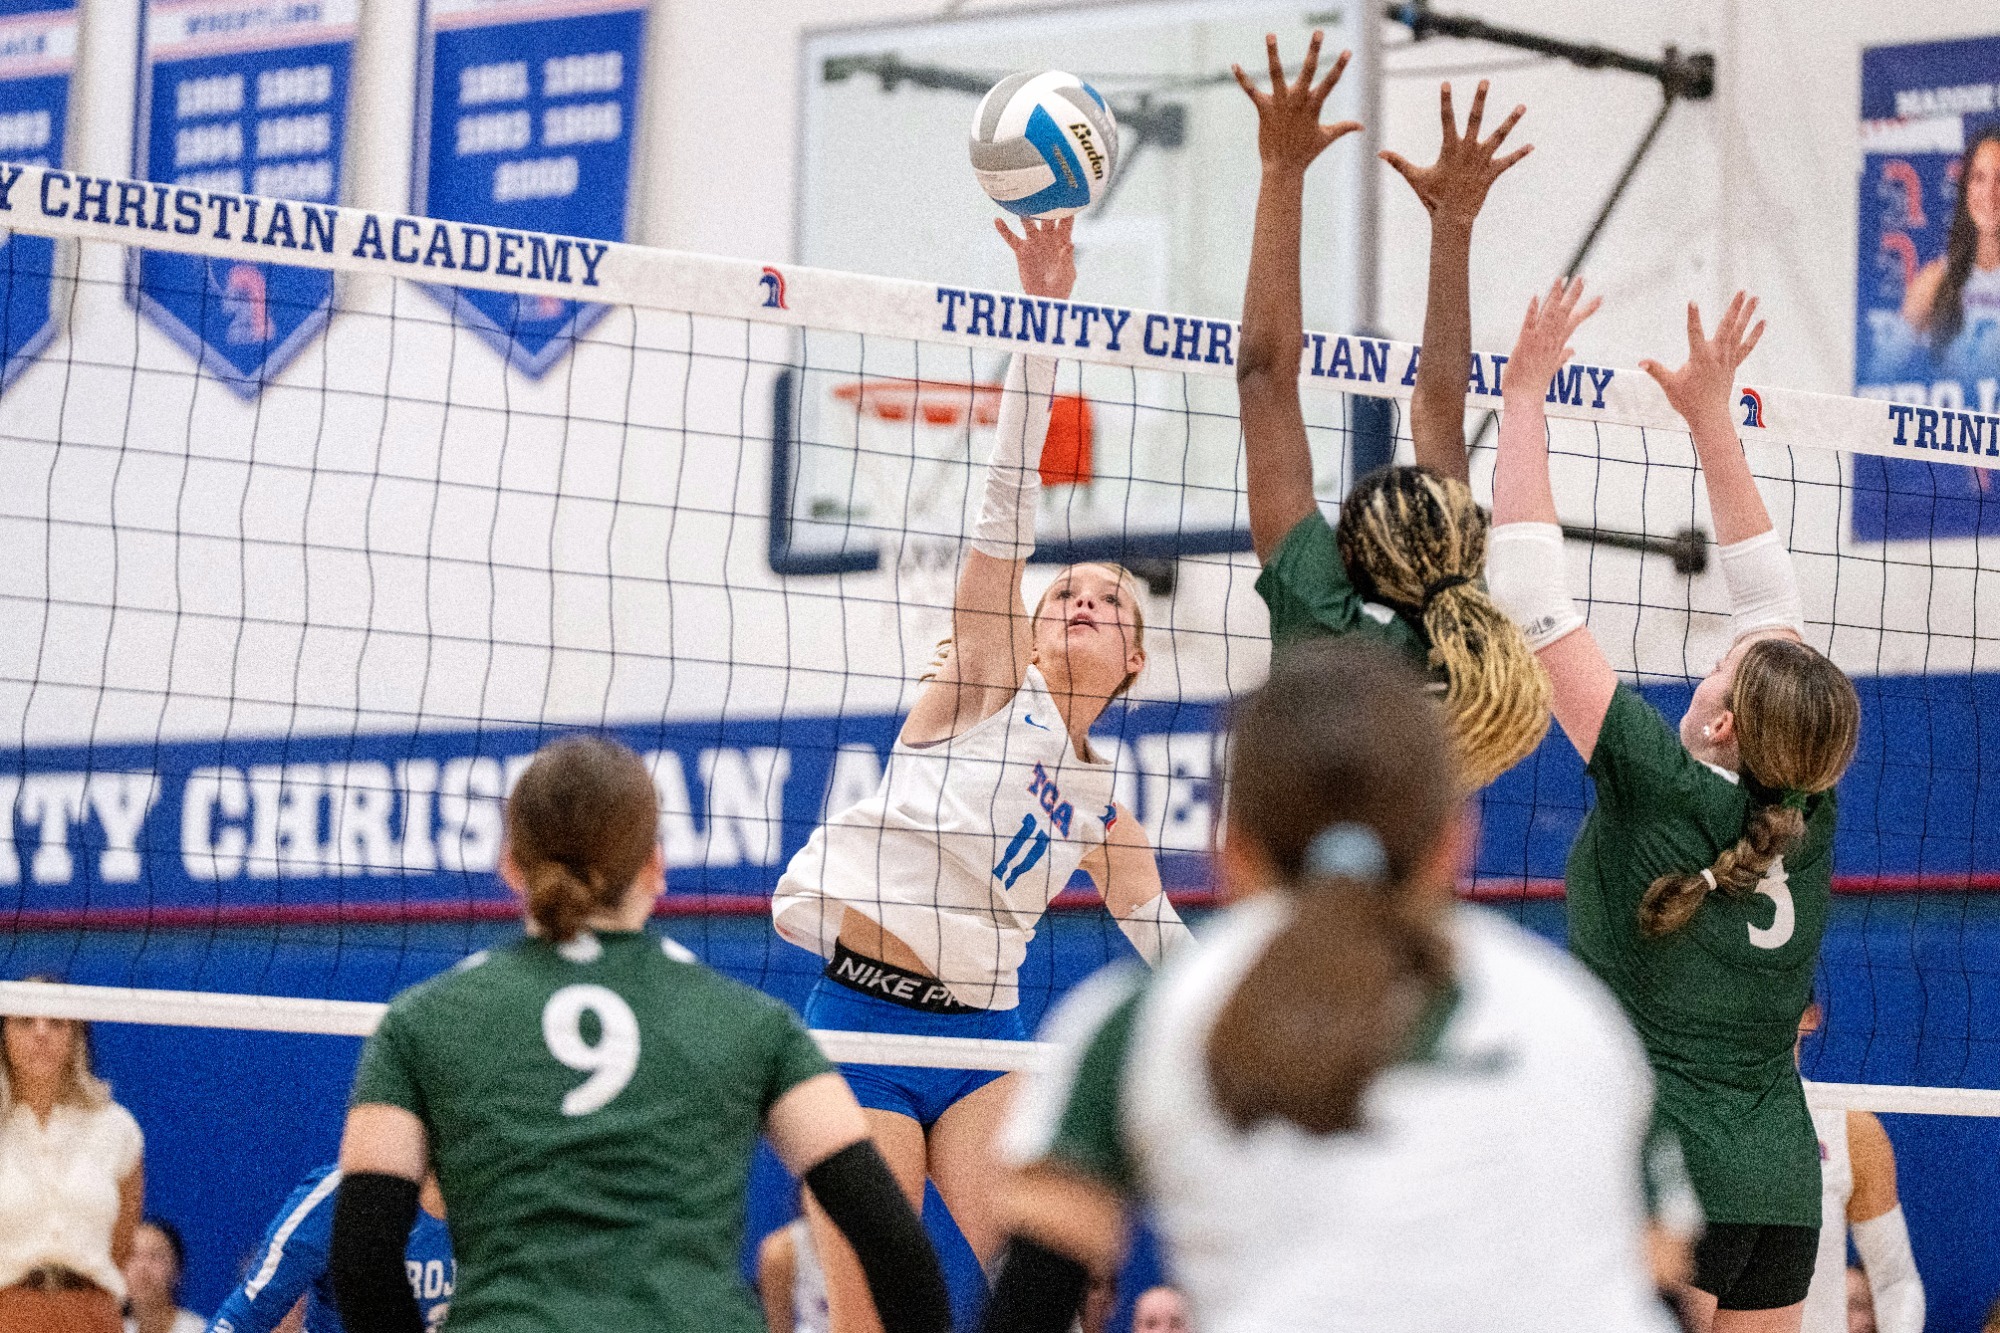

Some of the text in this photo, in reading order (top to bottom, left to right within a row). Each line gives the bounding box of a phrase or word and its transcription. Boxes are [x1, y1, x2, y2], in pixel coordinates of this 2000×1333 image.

[1069, 123, 1105, 180] Baden
[41, 170, 337, 254] CHRISTIAN
[352, 213, 609, 287] ACADEMY
[937, 287, 1131, 352] TRINITY
[1143, 313, 1391, 383] CHRIAN
[180, 746, 792, 883] CHRISAN
[1026, 759, 1075, 841] TCA
[991, 812, 1051, 891] 11
[836, 956, 922, 1001] NIKE
[541, 984, 641, 1117] 9
